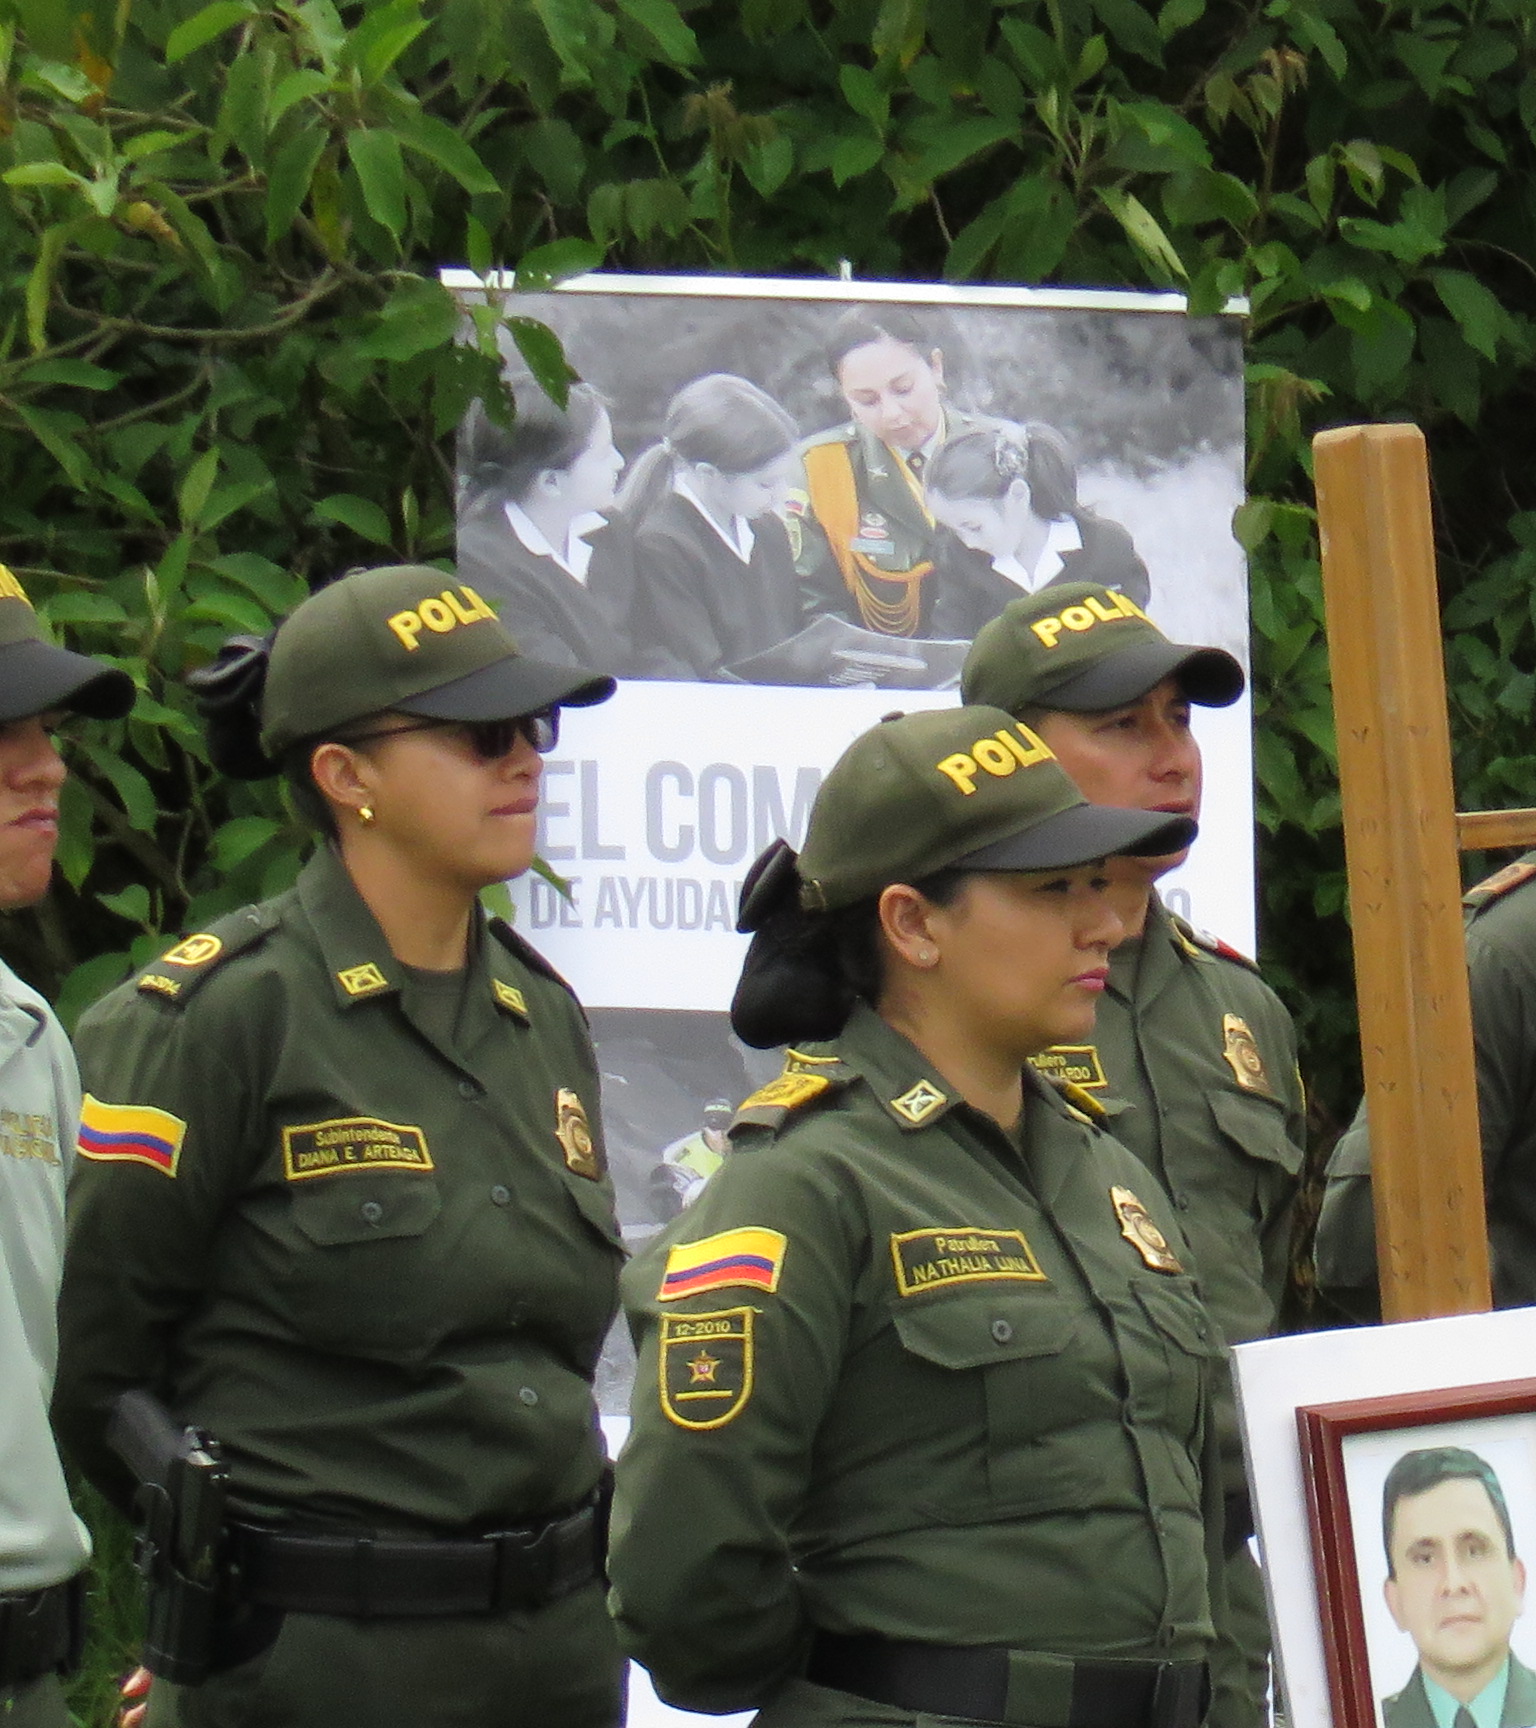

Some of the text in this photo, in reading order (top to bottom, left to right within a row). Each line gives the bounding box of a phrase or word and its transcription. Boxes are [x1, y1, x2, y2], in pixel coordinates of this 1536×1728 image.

[535, 760, 627, 861] EL
[911, 1255, 992, 1285] NATHALIA
[674, 1320, 732, 1337] 12-2010
